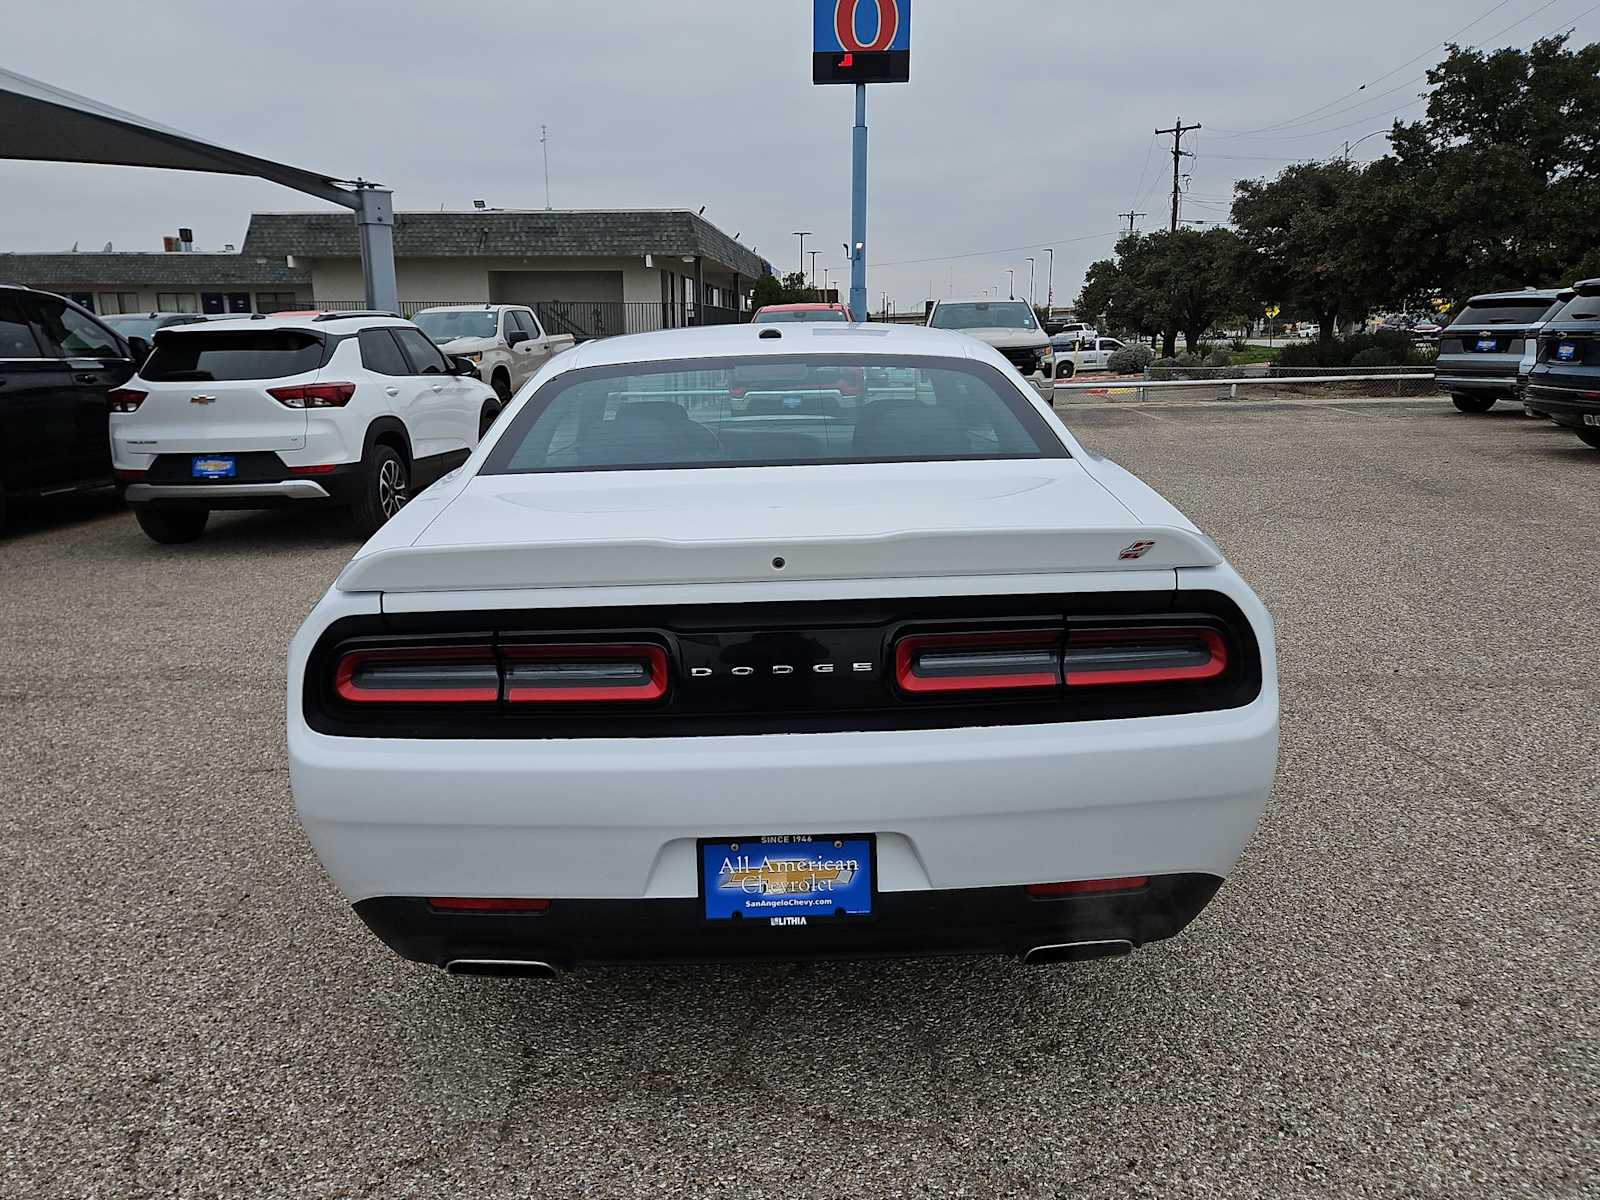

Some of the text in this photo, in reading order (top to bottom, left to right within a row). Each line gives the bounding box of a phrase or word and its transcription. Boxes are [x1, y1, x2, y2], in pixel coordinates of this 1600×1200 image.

[691, 662, 873, 677] DODGE
[760, 835, 813, 844] SINCE 1946
[718, 854, 860, 875] All American
[741, 873, 834, 895] Chevrolet
[745, 899, 832, 908] SanAngeloChevy.com
[779, 916, 807, 926] LITHIA
